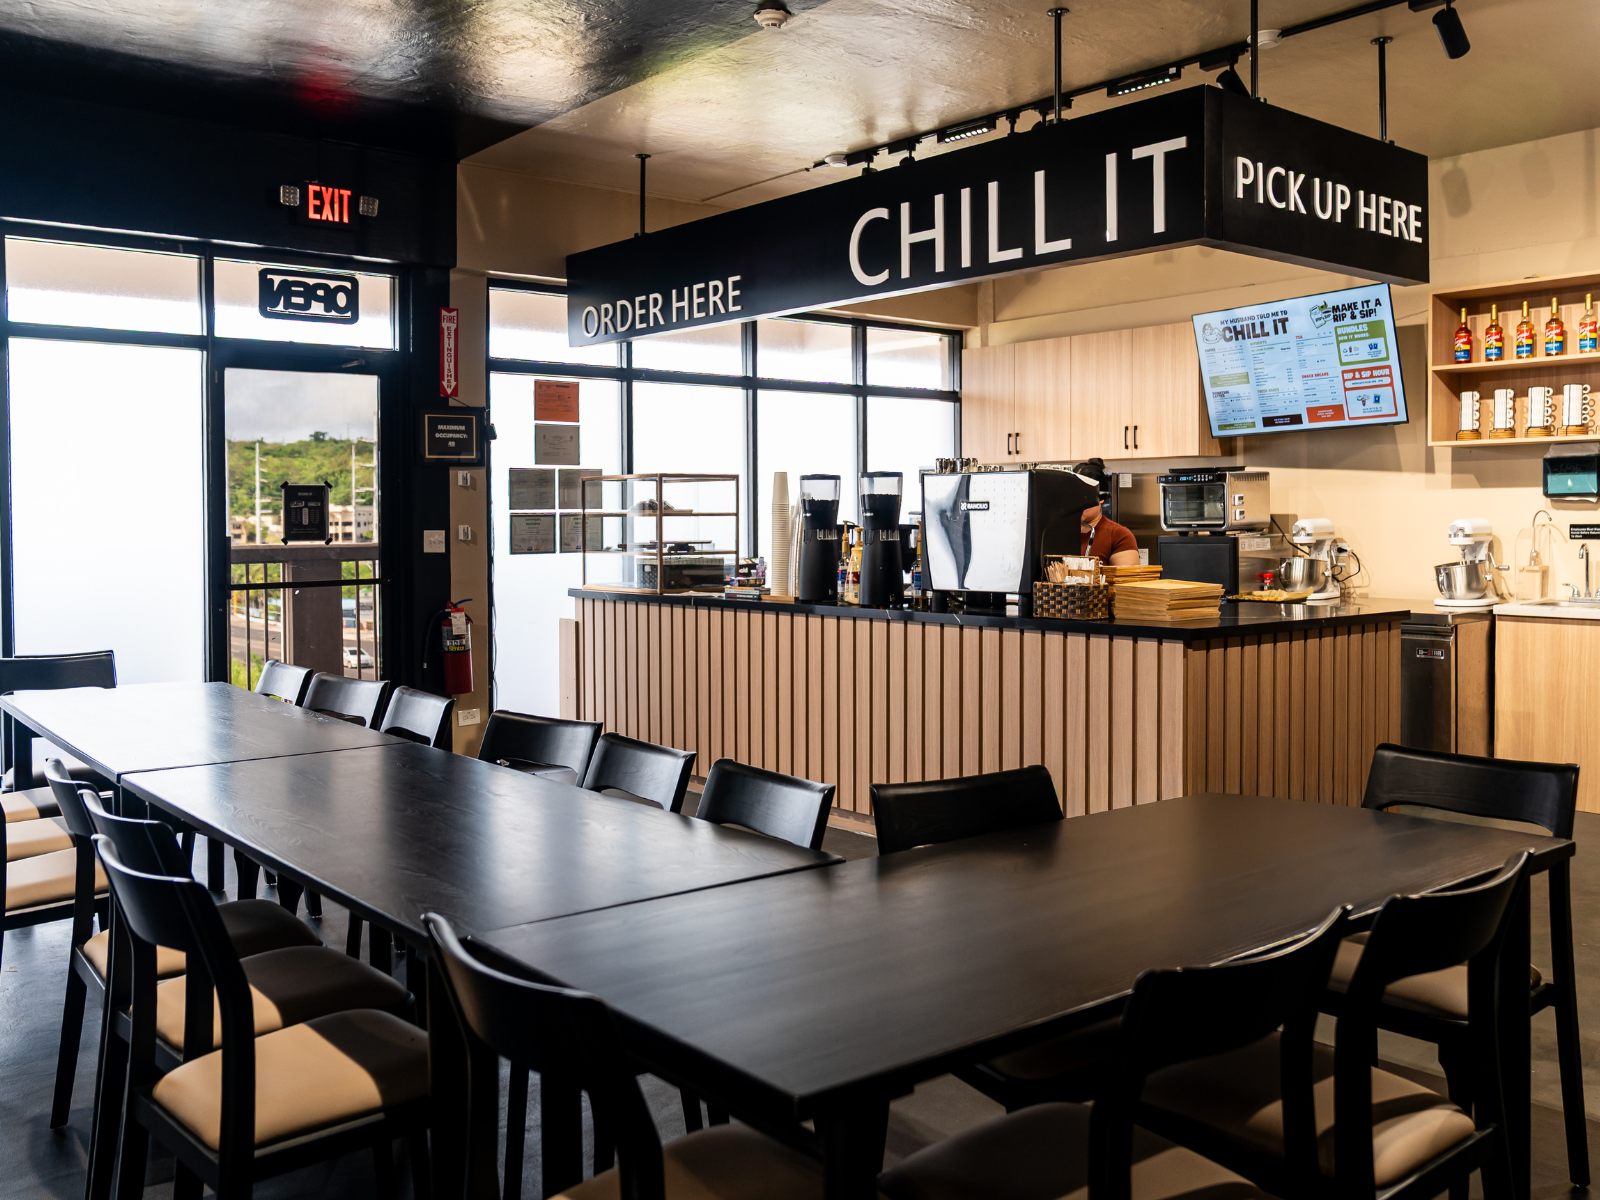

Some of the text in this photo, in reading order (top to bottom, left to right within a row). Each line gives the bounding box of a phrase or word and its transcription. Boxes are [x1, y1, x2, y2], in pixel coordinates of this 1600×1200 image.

[308, 184, 352, 224] EXIT
[1236, 156, 1422, 243] PICK UP HERE
[849, 136, 1187, 286] CHILL IT
[582, 275, 742, 338] ORDER HERE
[1331, 298, 1382, 314] MAKE IT A
[442, 314, 456, 325] FIRE
[1230, 316, 1256, 324] HUSBAND
[1333, 308, 1377, 323] RIP & SIP!
[1221, 317, 1289, 343] CHILL IT
[1336, 324, 1368, 335] BUNDLES
[1361, 370, 1372, 378] SIP
[1372, 368, 1390, 377] HOUR
